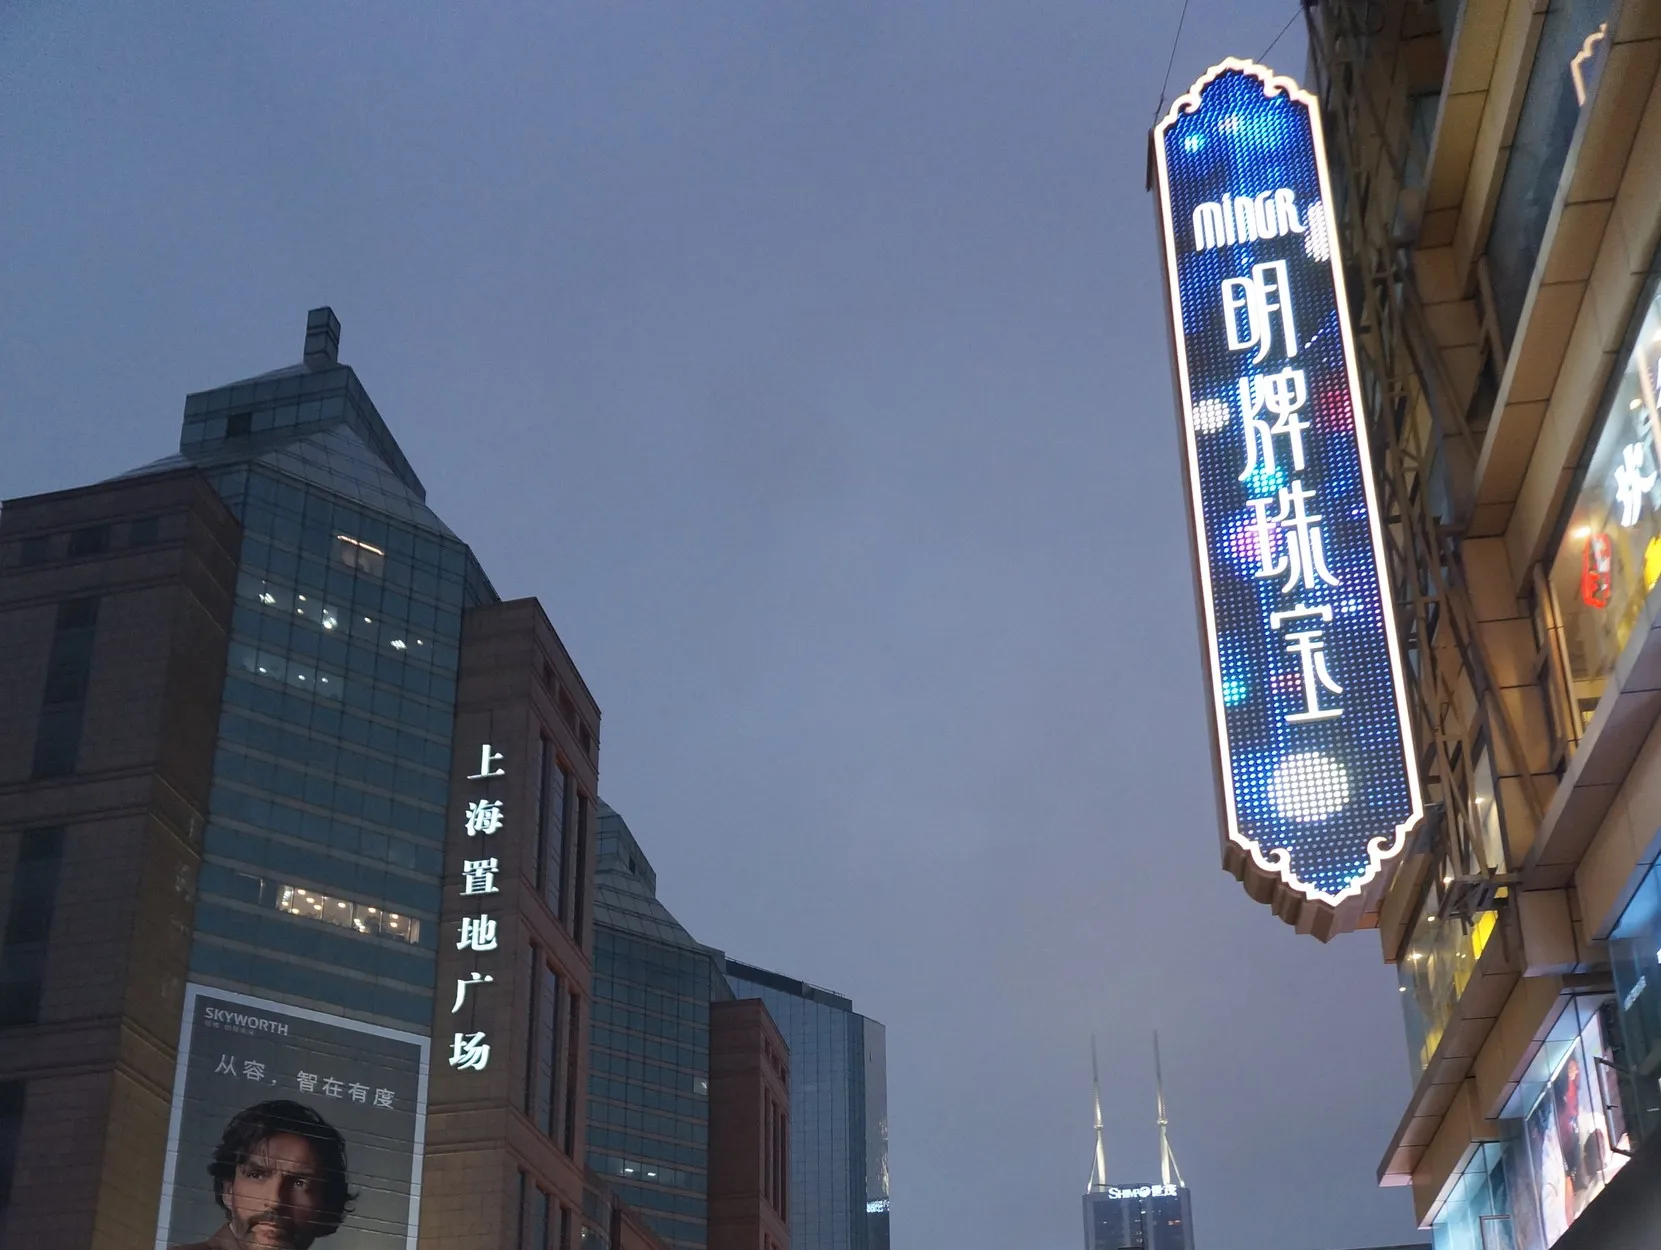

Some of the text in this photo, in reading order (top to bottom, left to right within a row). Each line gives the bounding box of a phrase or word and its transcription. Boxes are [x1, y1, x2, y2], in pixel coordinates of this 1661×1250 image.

[1221, 259, 1344, 723] 明牌珠宝
[204, 1007, 289, 1036] SKYWORTH
[449, 744, 505, 1071] 上海置地广场
